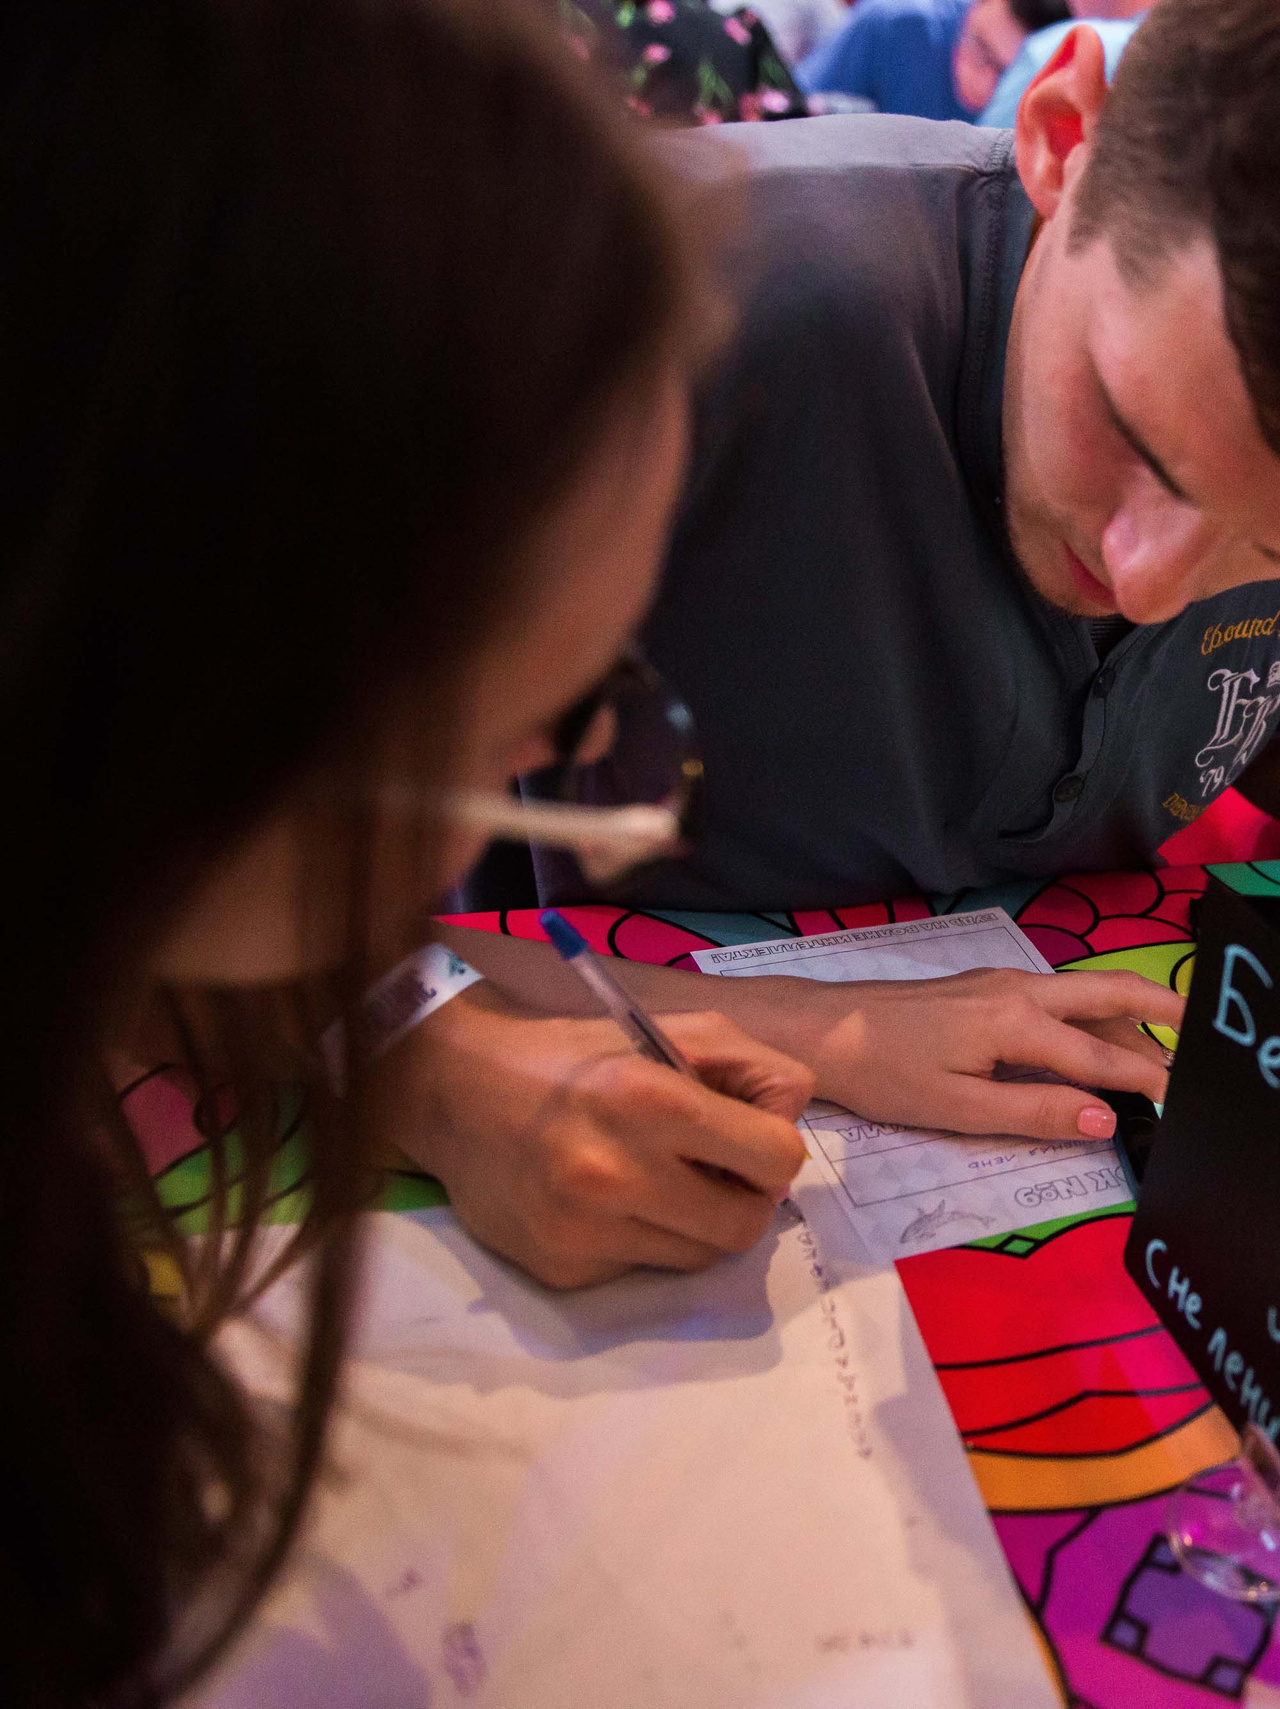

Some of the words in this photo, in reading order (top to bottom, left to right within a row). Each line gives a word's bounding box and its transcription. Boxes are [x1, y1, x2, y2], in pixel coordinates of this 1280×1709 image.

[851, 922, 919, 942] ВОЛНЕ
[920, 918, 949, 932] НА
[710, 931, 852, 964] ИНТЕЛЛЕКТА!
[967, 1152, 1018, 1172] ЛЕНЬ
[1012, 1168, 1090, 1209] №9
